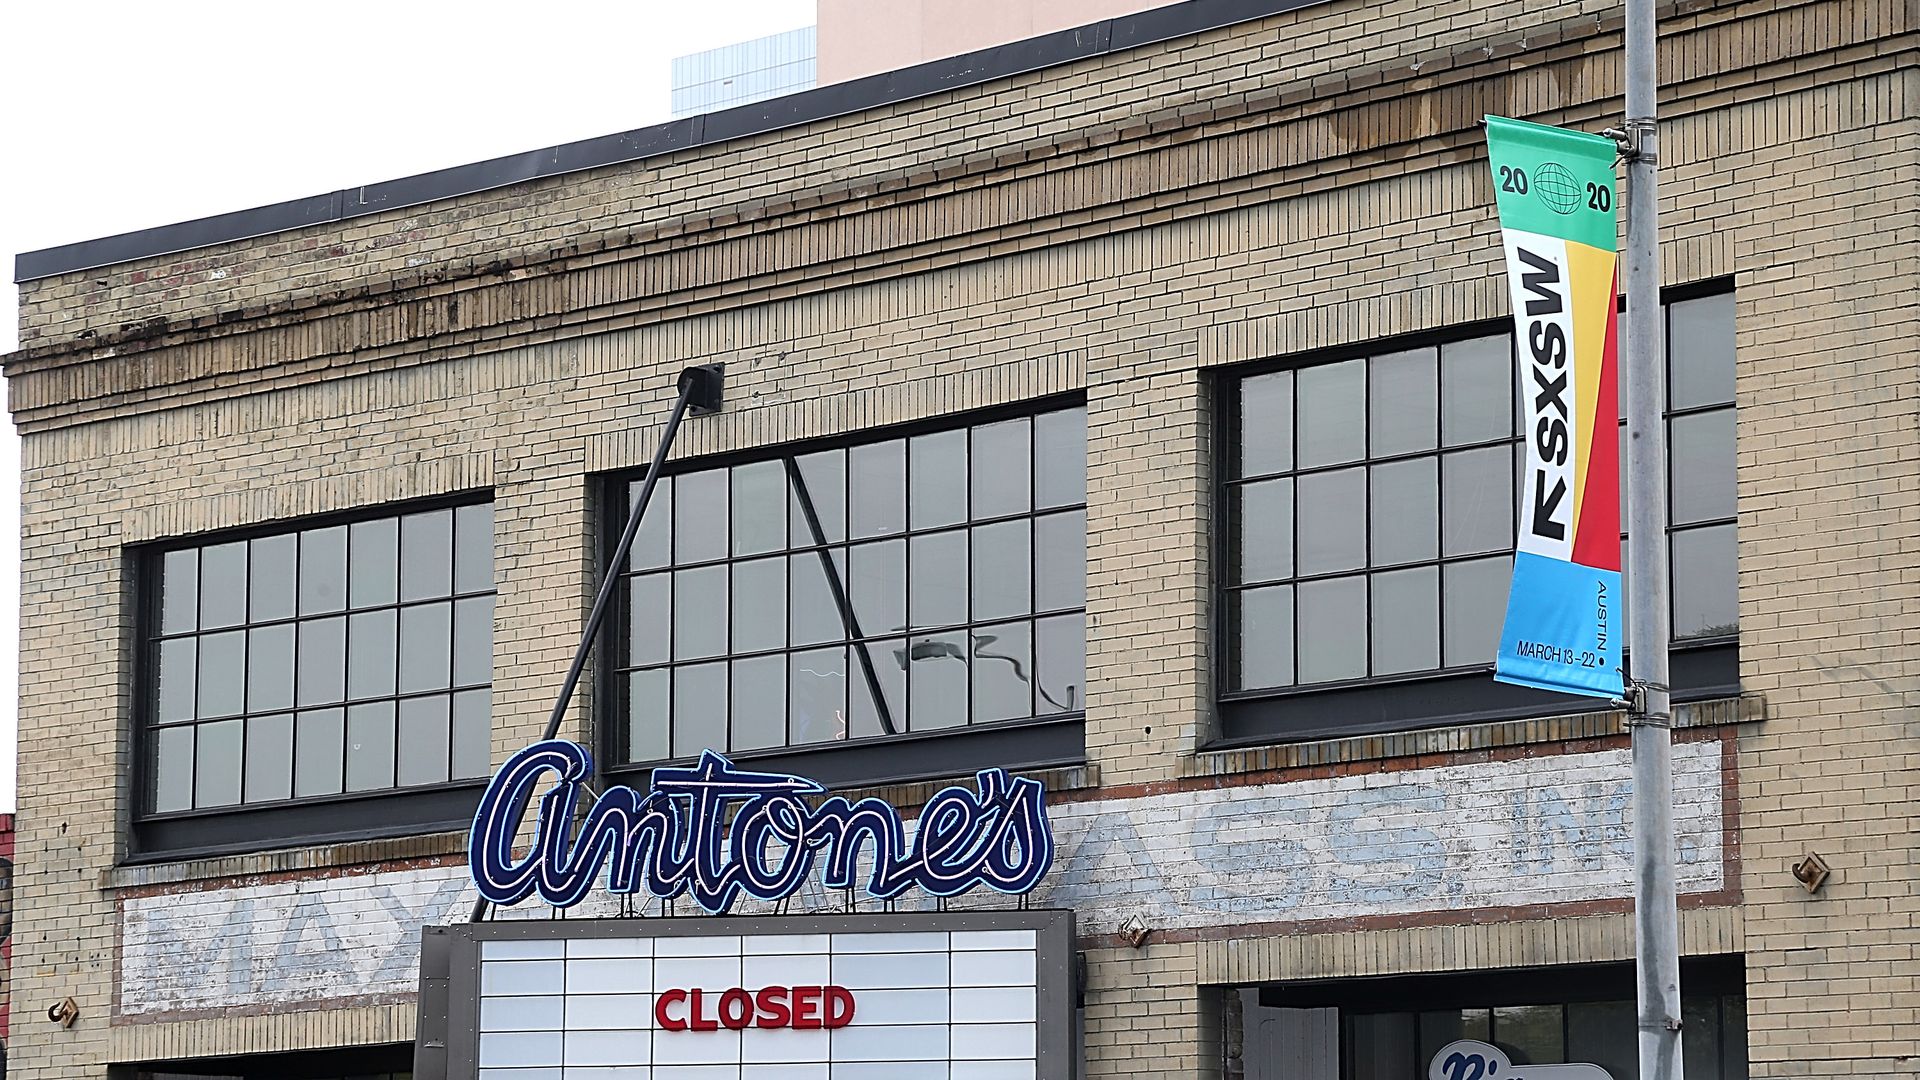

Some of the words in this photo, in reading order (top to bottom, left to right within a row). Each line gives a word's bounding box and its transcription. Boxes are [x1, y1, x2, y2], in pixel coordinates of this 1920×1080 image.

[1500, 166, 1528, 195] 20
[1586, 182, 1611, 213] 20
[1516, 246, 1568, 467] SXSW
[1597, 580, 1607, 651] AUSTIN
[1516, 640, 1561, 662] MARCH
[655, 986, 855, 1032] CLOSED
